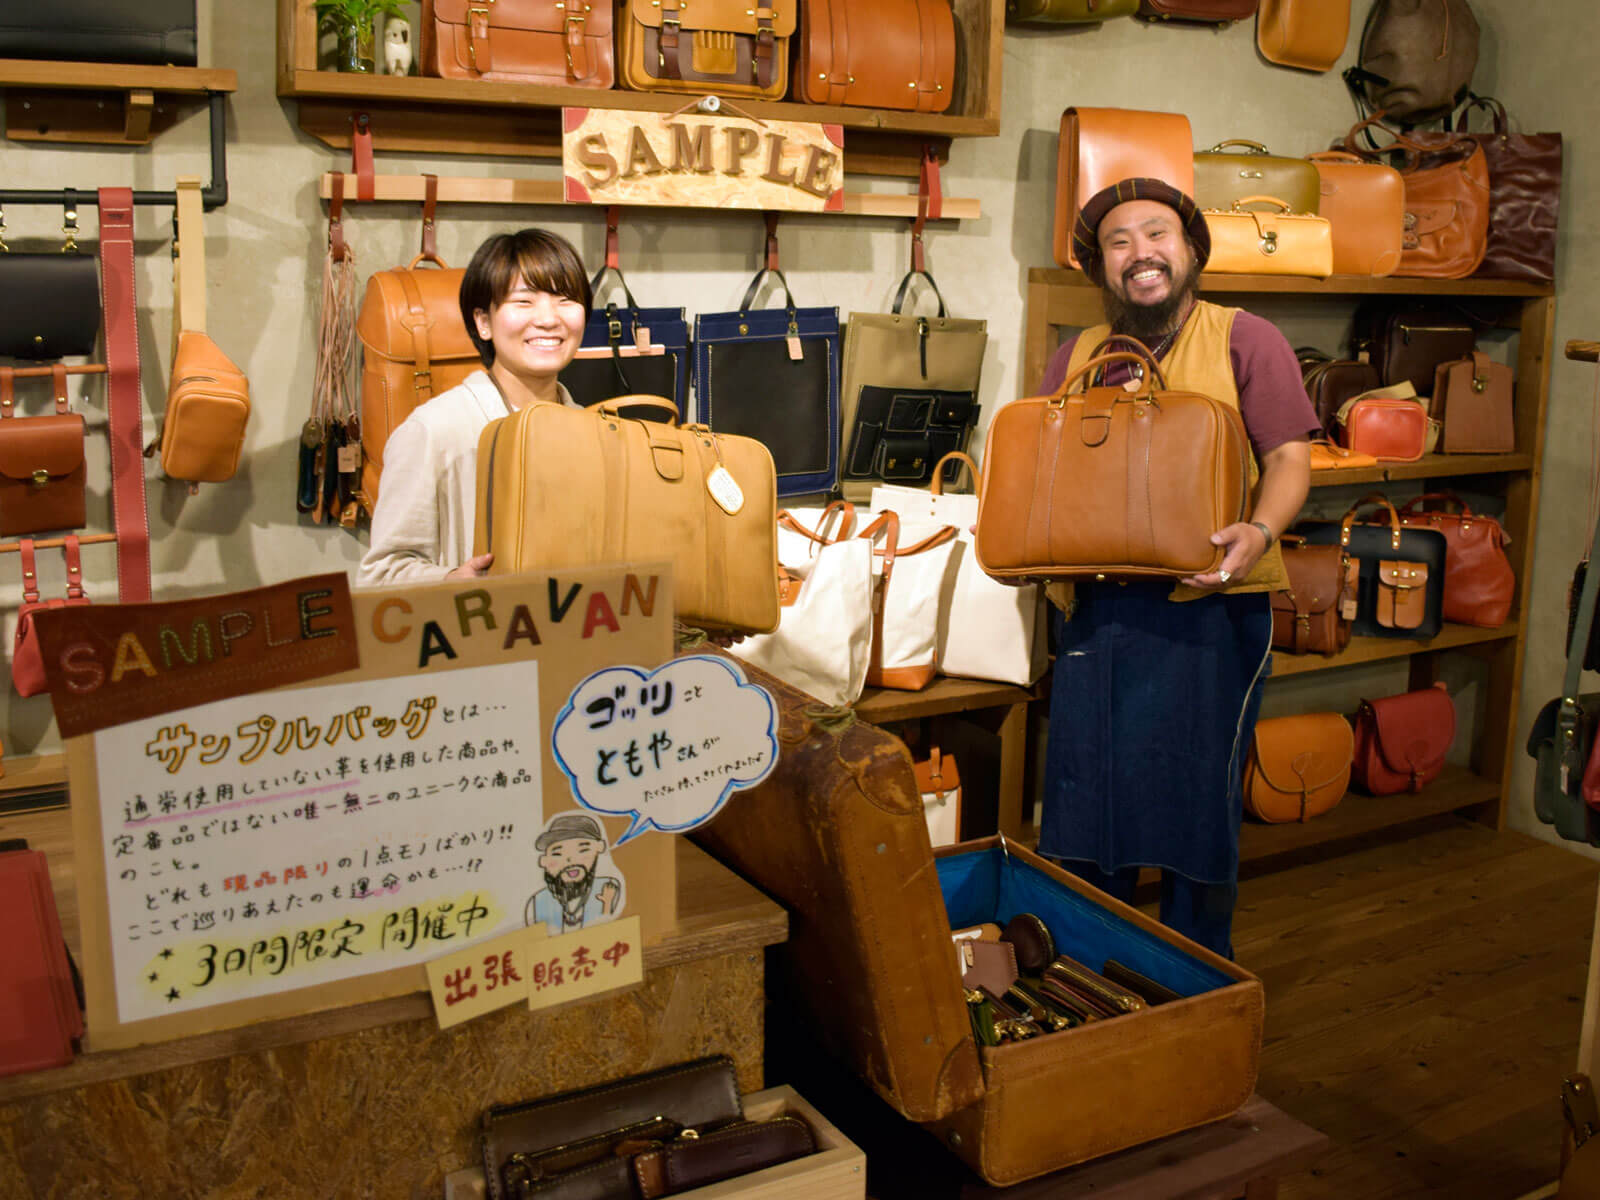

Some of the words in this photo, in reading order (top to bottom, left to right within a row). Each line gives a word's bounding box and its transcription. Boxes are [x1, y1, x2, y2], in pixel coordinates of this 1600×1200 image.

[575, 122, 838, 199] SAMPLE
[60, 588, 338, 694] SAMPLE
[371, 573, 658, 668] CARAVAN
[120, 858, 200, 881] のこと。
[444, 951, 522, 1007] 出張
[532, 941, 631, 991] 販売中
